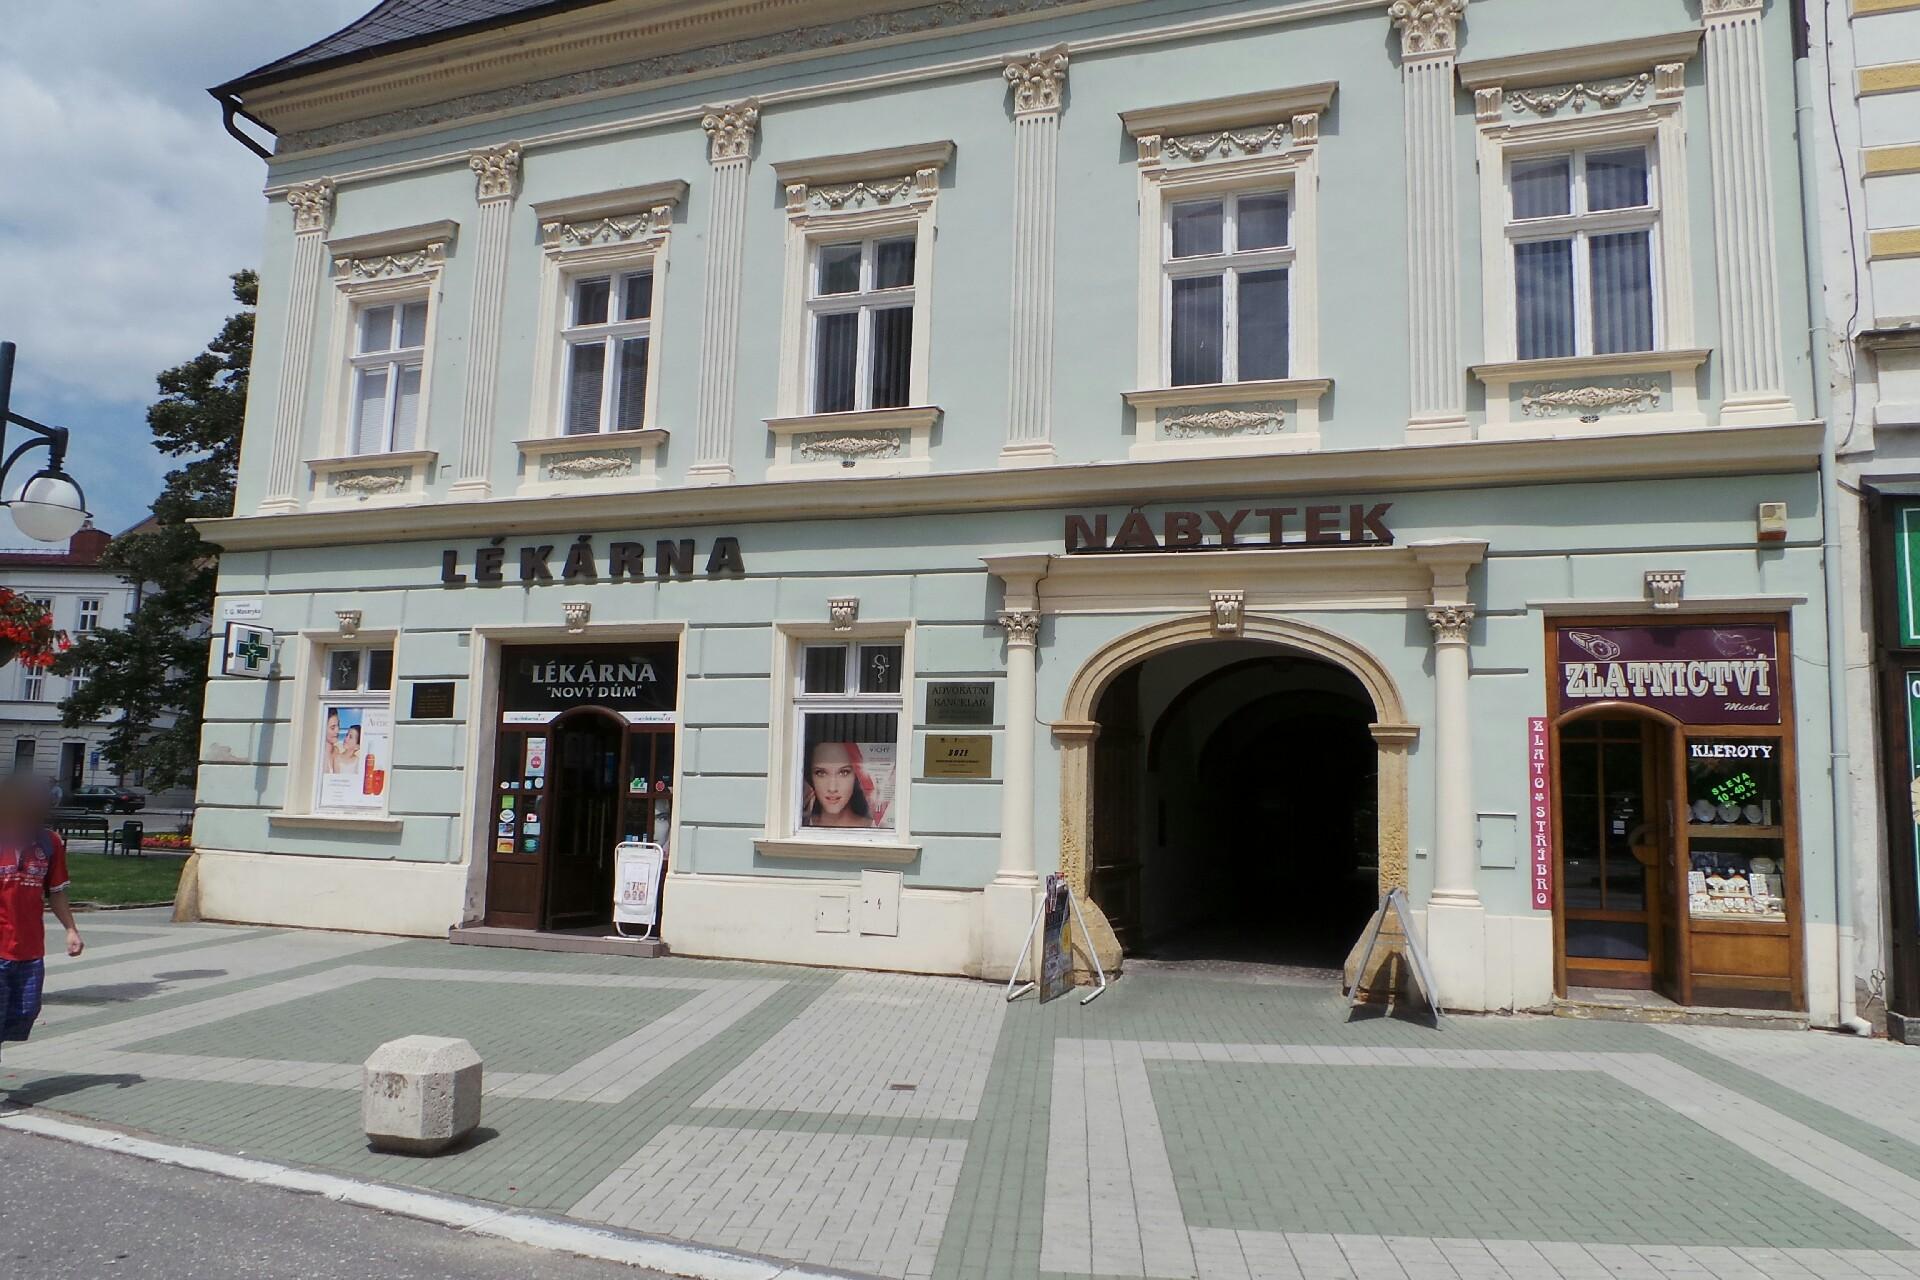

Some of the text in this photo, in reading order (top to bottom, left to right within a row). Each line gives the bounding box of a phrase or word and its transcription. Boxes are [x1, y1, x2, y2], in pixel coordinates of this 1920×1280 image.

[441, 535, 745, 582] LÉKÁRNA
[531, 660, 657, 684] LÉKÁRNA
[1565, 653, 1771, 698] ZLATNICTVÍ
[1724, 702, 1770, 712] Michal
[1533, 720, 1545, 789] ZLATO
[1691, 744, 1773, 758] KLENOTY
[1711, 773, 1750, 795] SLEVA
[1535, 805, 1548, 904] STŘÍBRO
